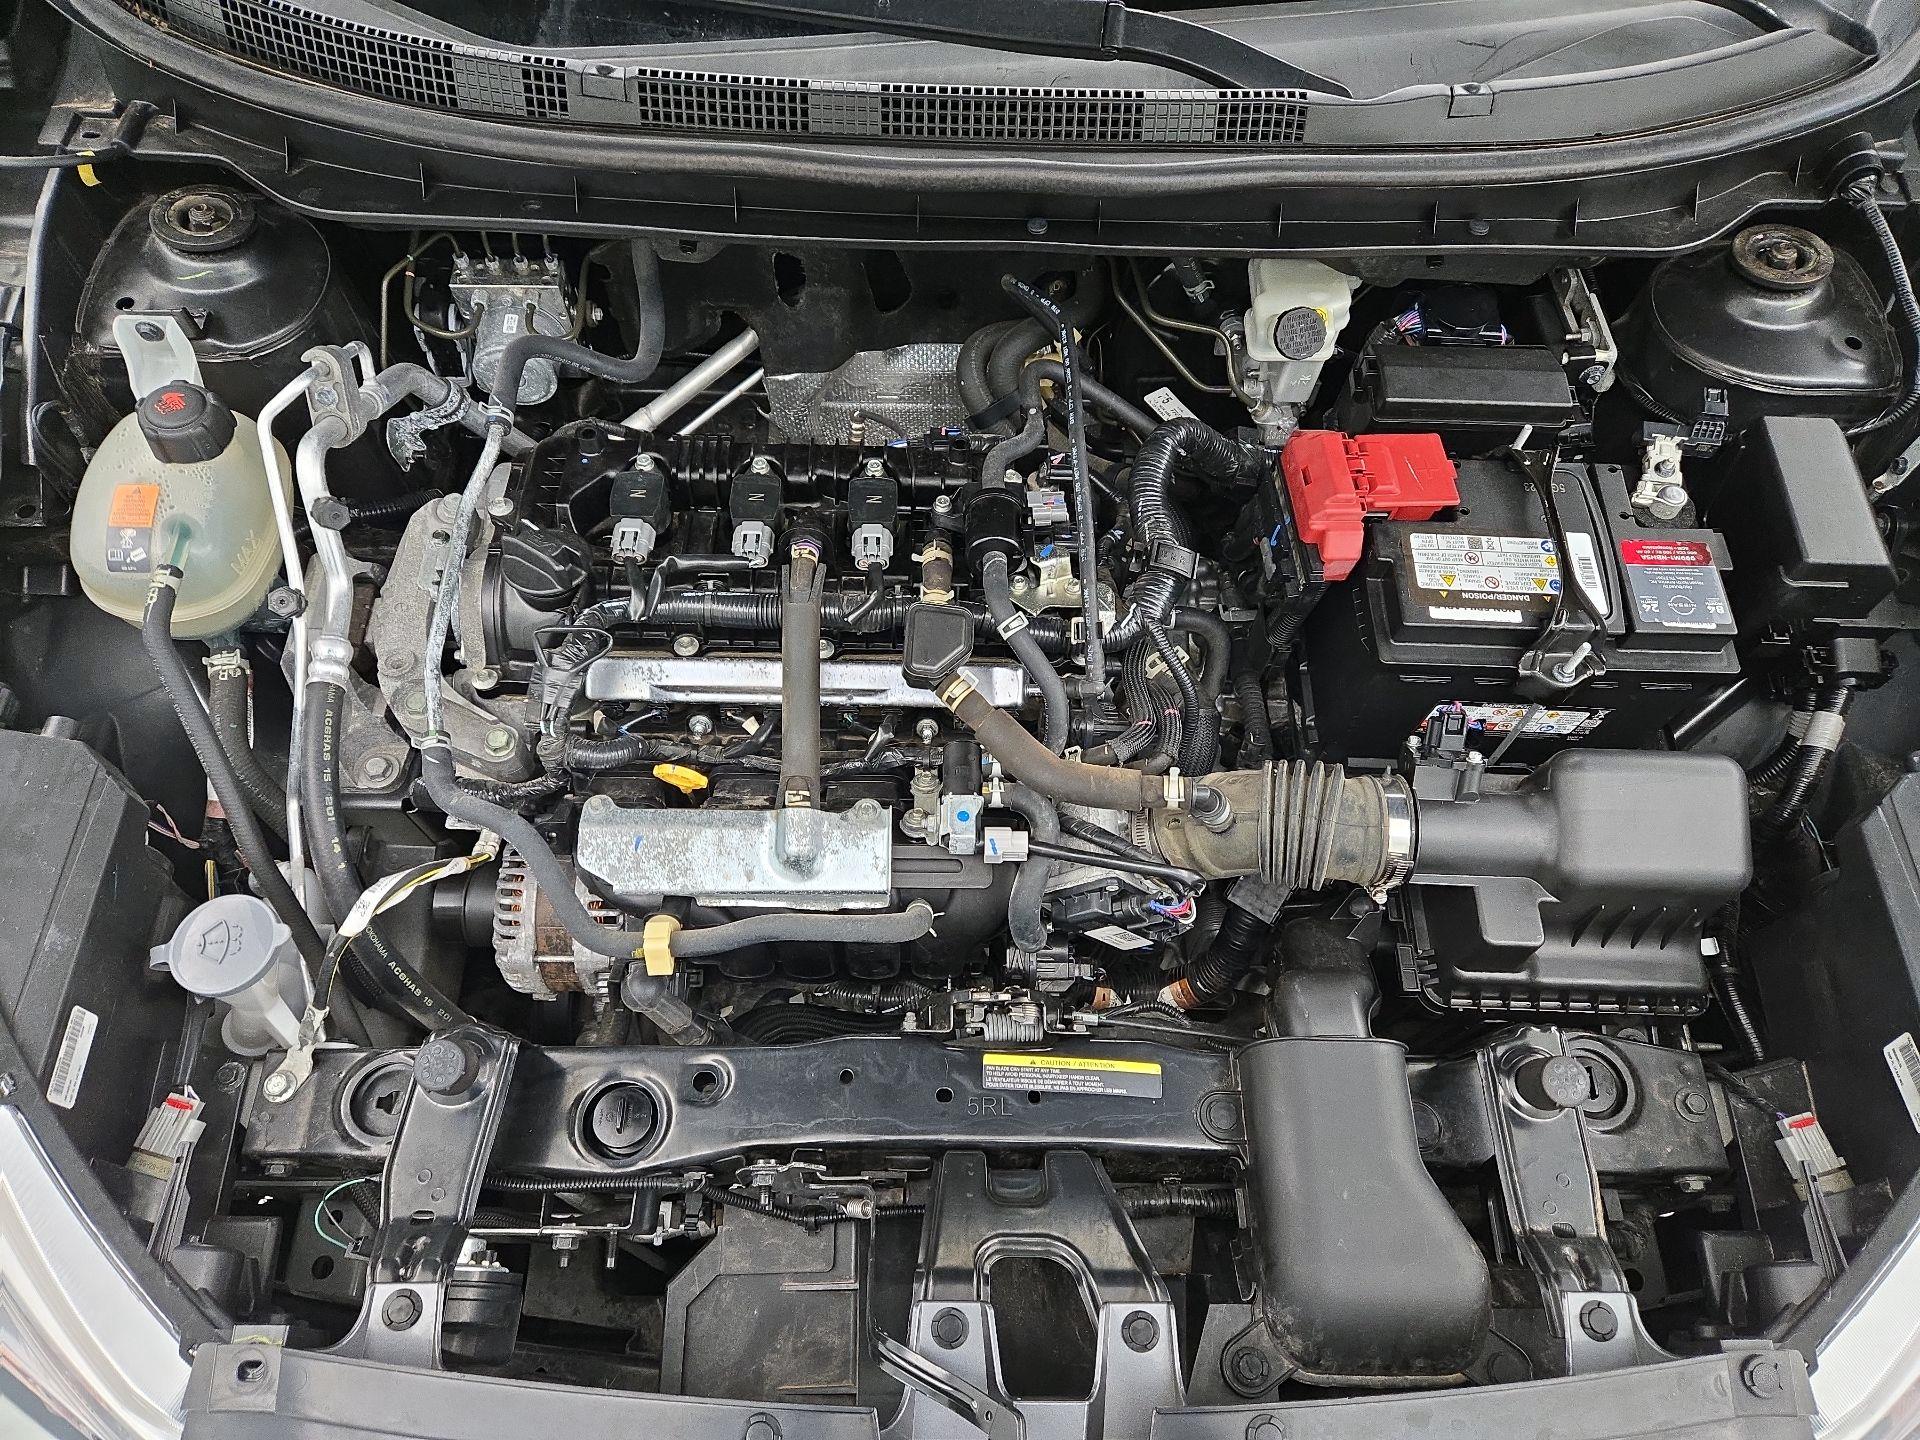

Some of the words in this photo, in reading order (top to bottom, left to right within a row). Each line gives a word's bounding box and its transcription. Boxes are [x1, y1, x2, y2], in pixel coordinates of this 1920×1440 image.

[1461, 592, 1530, 602] DANGER/POISON
[323, 768, 332, 782] 15
[1078, 1061, 1116, 1069] ATTENTION
[967, 1096, 1013, 1116] 5RL
